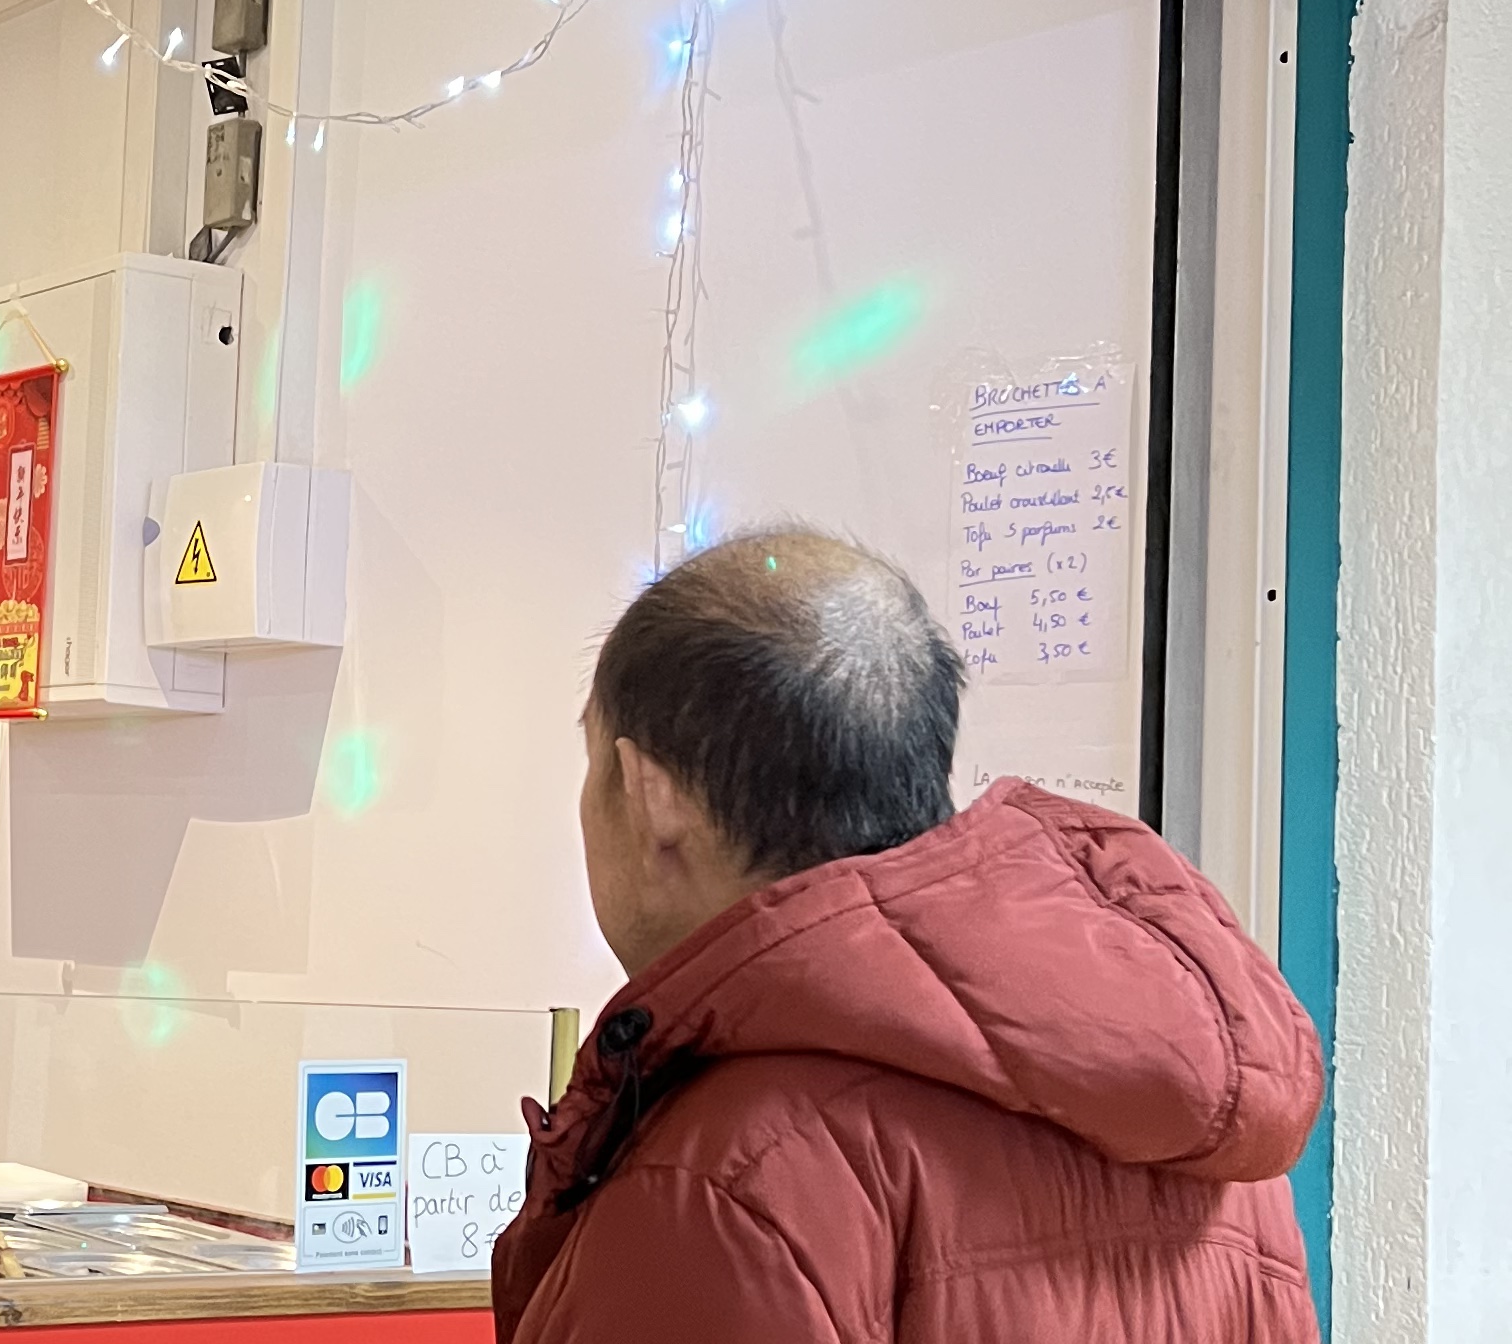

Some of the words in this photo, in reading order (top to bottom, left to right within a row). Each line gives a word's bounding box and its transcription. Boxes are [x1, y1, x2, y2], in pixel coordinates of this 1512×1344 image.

[974, 413, 1062, 436] EMPORTER
[963, 521, 992, 552] Tofu
[422, 1141, 467, 1179] CB
[480, 1141, 507, 1175] à
[358, 1171, 392, 1188] VISA
[413, 1188, 475, 1229] partir
[489, 1184, 522, 1213] de
